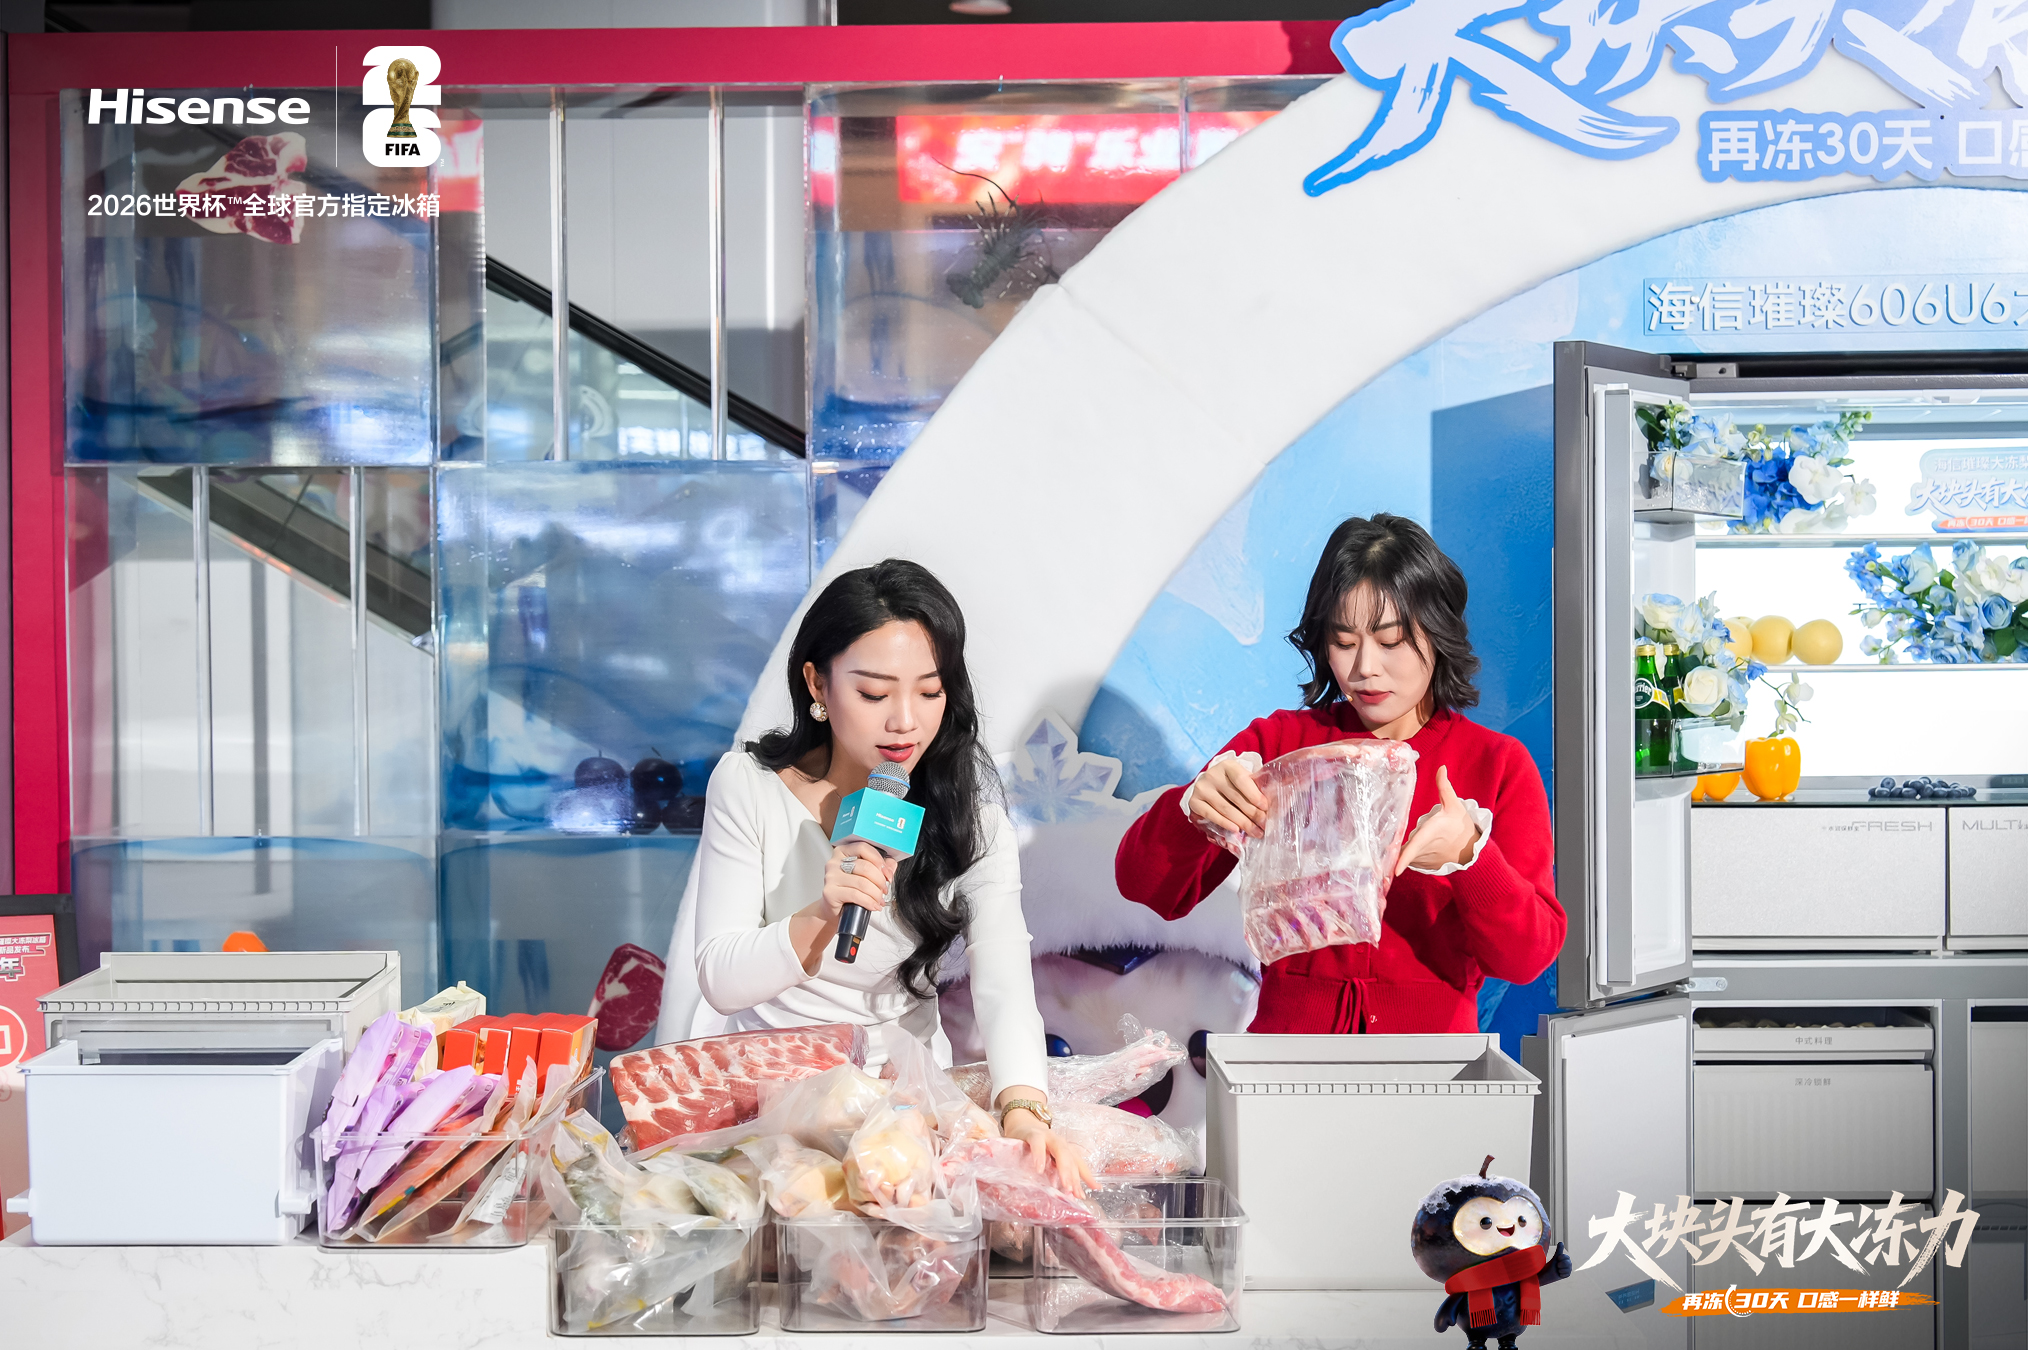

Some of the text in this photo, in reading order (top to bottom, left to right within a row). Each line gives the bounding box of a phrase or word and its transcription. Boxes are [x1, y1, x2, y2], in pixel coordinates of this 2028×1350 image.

[1708, 119, 1933, 171] 再冻30天
[1795, 1037, 1833, 1045] 中式料理
